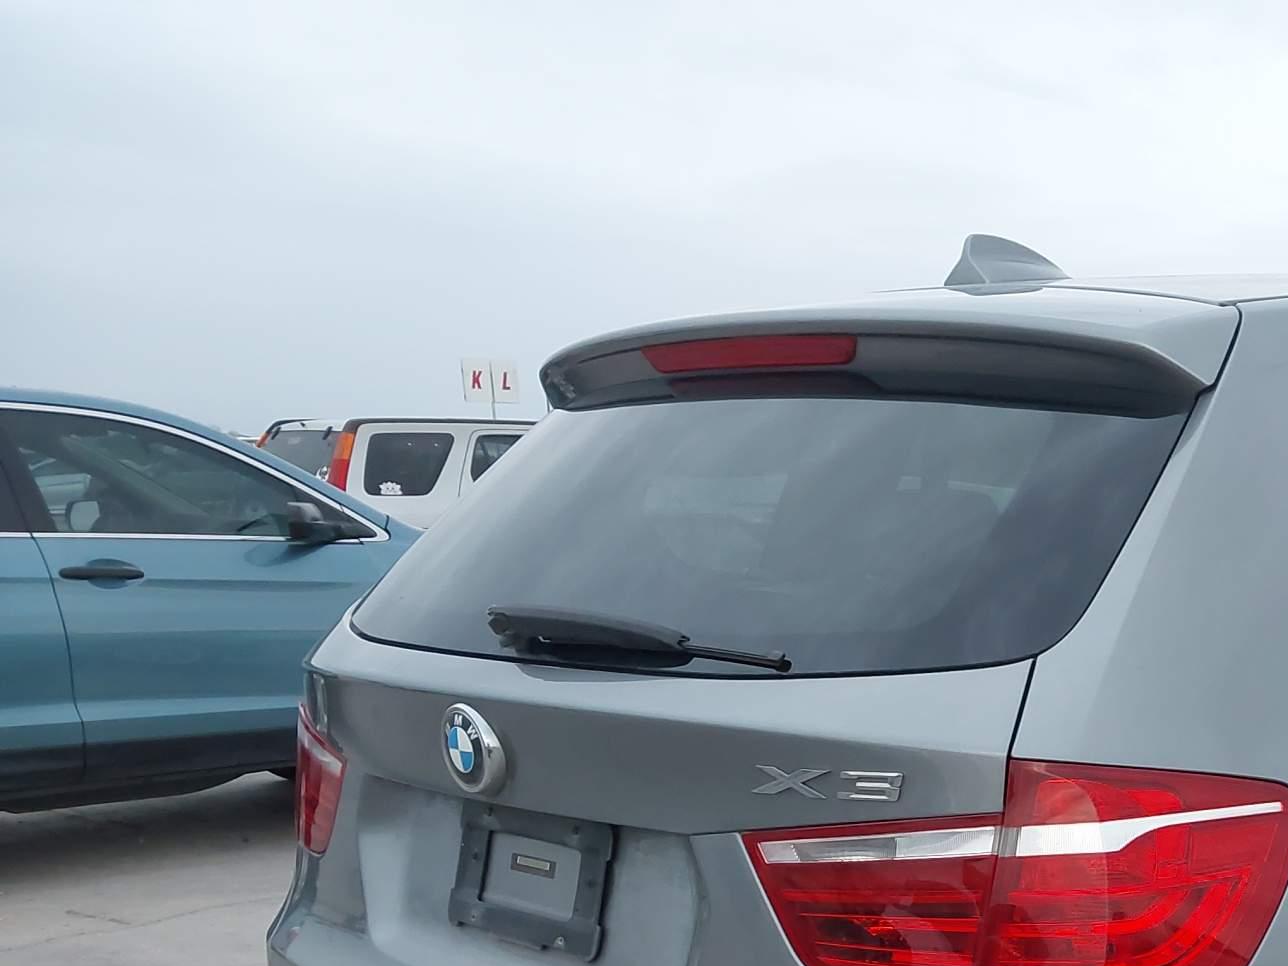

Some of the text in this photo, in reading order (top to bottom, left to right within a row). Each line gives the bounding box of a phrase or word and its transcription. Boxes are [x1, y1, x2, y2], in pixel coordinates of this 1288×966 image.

[472, 370, 482, 390] K
[502, 371, 511, 391] L
[752, 764, 904, 802] X3
